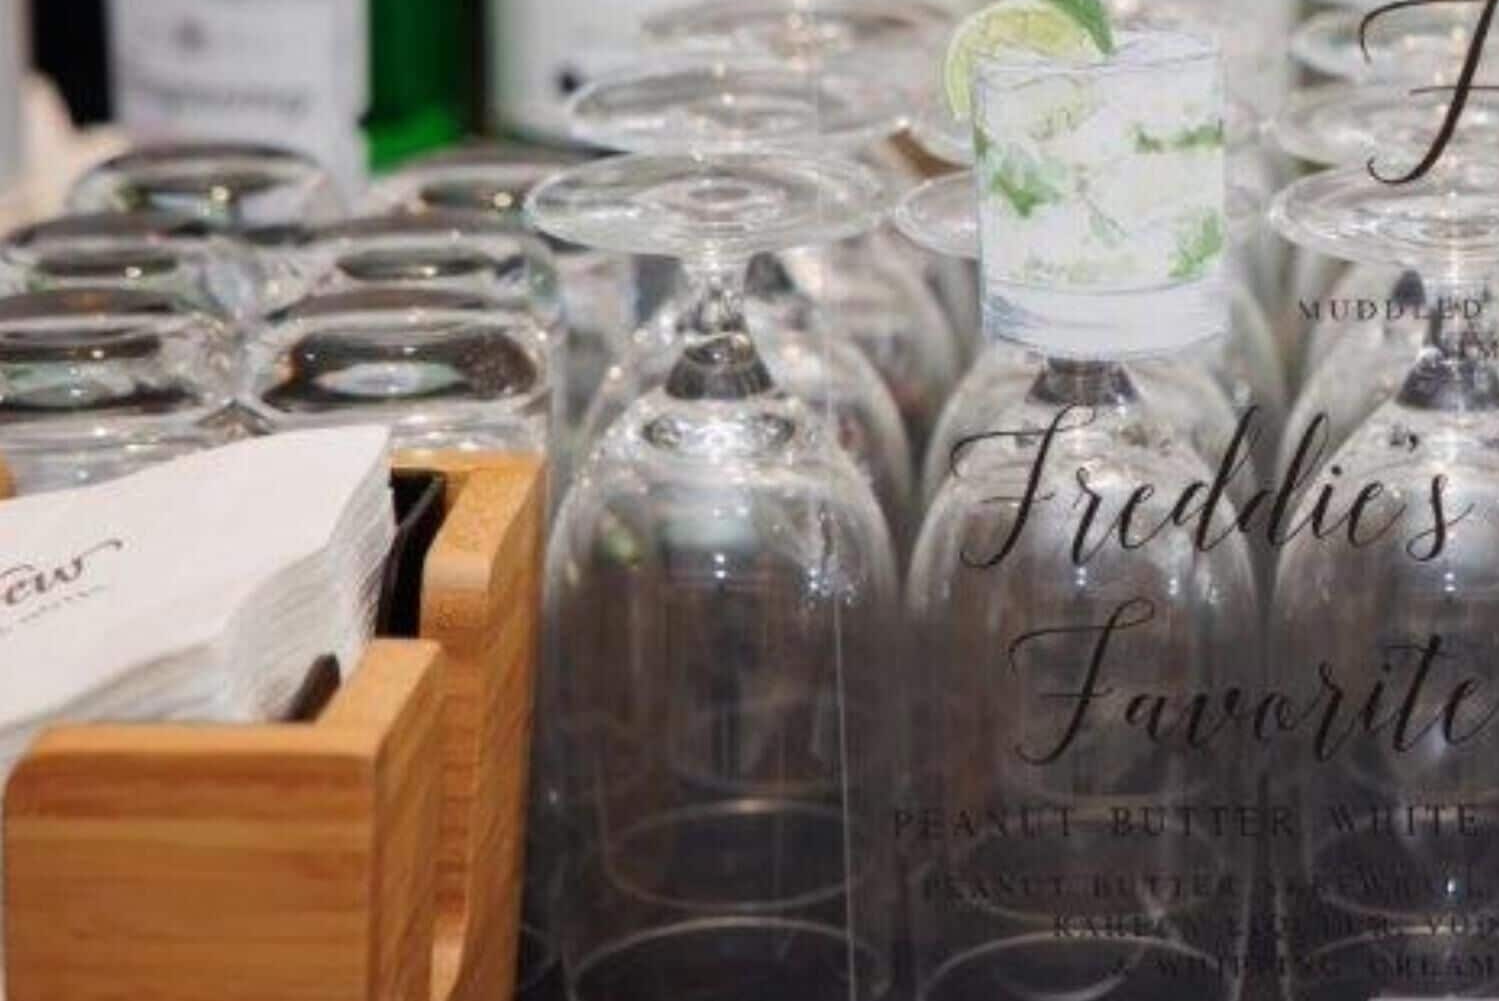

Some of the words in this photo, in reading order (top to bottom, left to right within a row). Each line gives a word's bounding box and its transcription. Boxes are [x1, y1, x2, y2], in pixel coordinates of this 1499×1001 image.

[949, 403, 1474, 569] Freddie's
[892, 806, 1073, 838] PEANUT
[1111, 805, 1296, 837] BUTTER
[1329, 804, 1481, 836] WHITE
